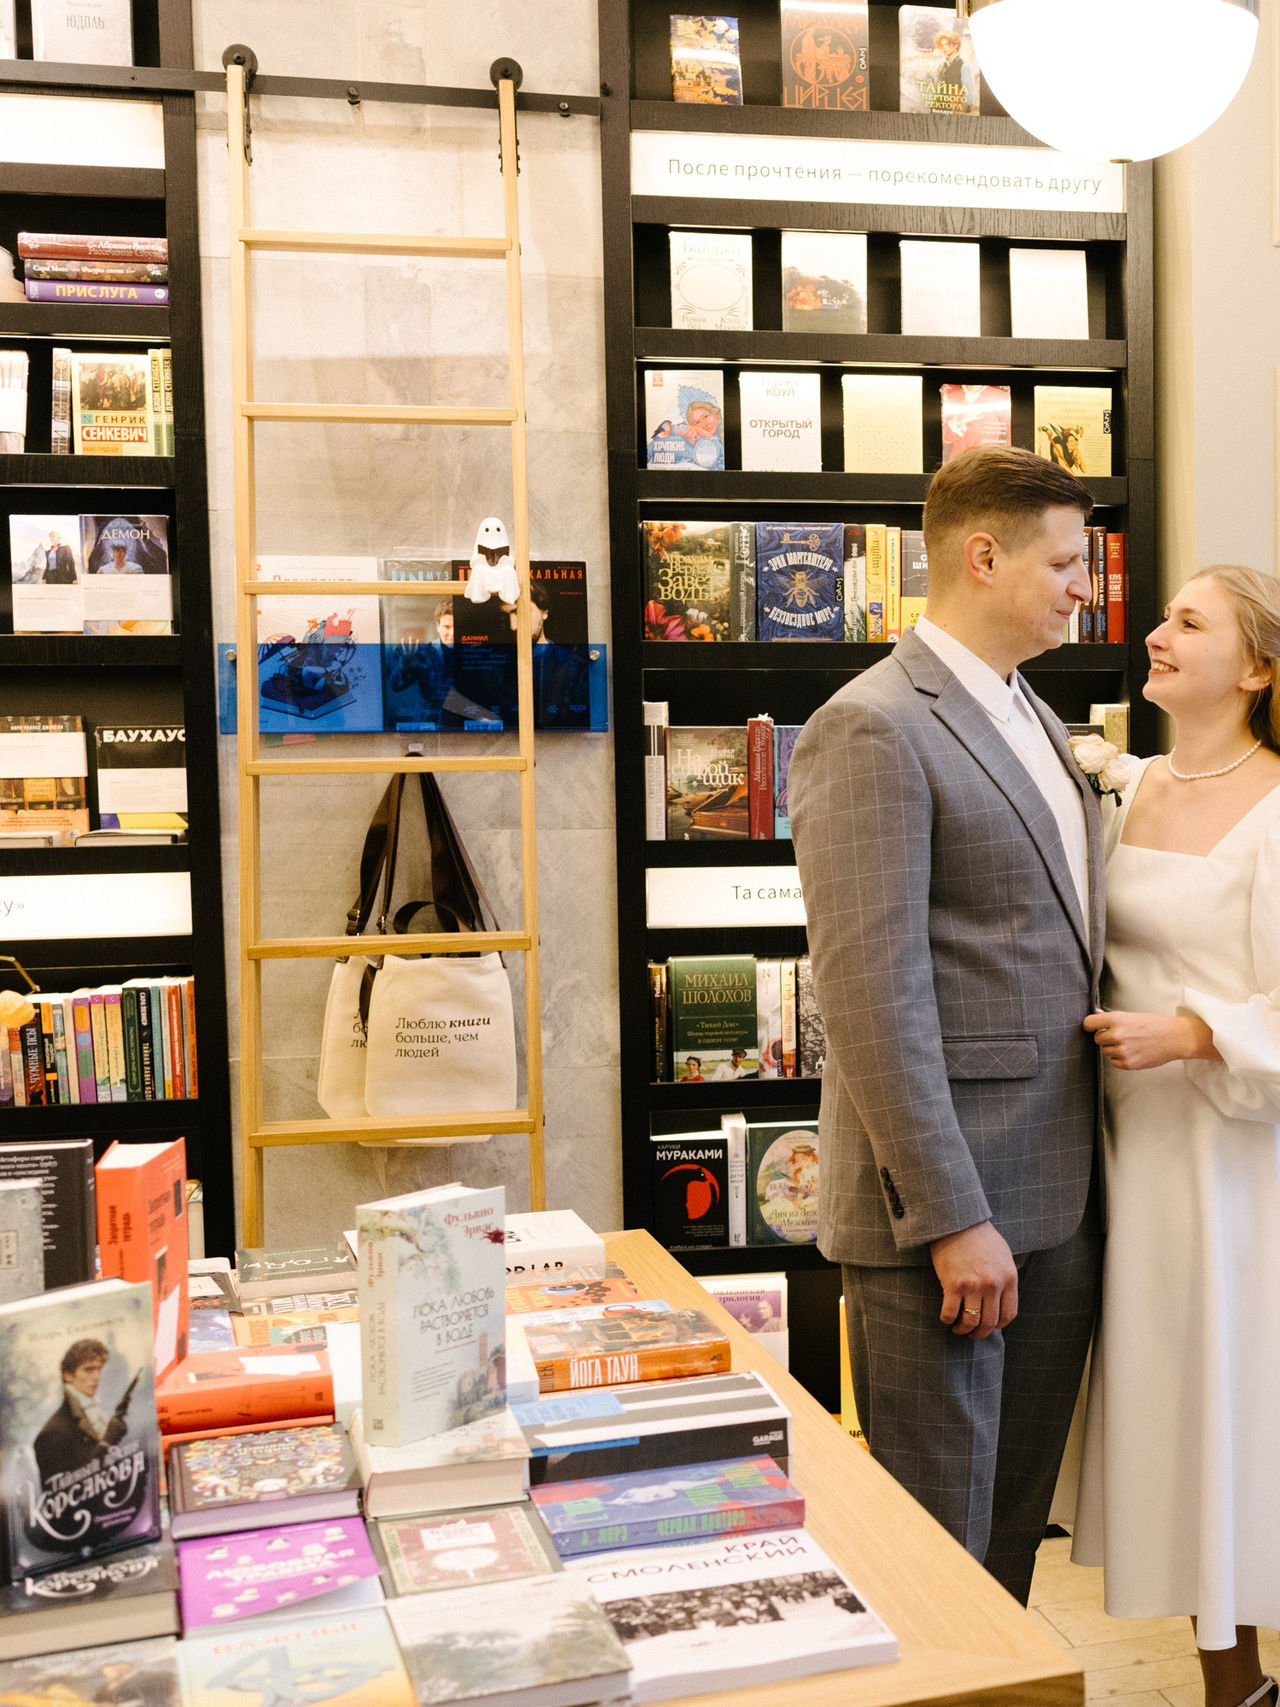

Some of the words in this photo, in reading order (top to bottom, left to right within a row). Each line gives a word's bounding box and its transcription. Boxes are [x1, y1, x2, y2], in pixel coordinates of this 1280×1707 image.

[66, 14, 105, 31] ЮДОЛЬ
[784, 14, 864, 34] МИЛЛЕР
[916, 81, 969, 96] ТАЙНА
[784, 85, 867, 110] ЦИРЦЕЯ
[922, 93, 968, 103] МЕРТВОГО
[925, 101, 963, 110] РЕКТОРА
[668, 159, 729, 177] После
[734, 163, 842, 182] прочтения
[868, 168, 1044, 190] порекомендовать
[1048, 176, 1102, 195] другу
[33, 264, 50, 273] Сара
[55, 284, 139, 299] ПРИСЛУГА
[682, 314, 707, 323] Роман
[766, 388, 795, 397] КОУЛ
[95, 416, 146, 424] ГЕНРИК
[750, 419, 813, 429] ОТКРЫТЫЙ
[82, 427, 147, 442] СЕНКЕВИЧ
[762, 429, 800, 438] ГОРОД
[653, 441, 686, 451] ХРУПКИЕ
[653, 453, 675, 464] ЛЮДИ
[101, 529, 150, 540] ДЕМОН
[660, 551, 713, 563] Абрахам
[768, 553, 787, 572] ЭРИН
[658, 569, 715, 590] Завет
[659, 587, 717, 605] воды
[815, 606, 836, 625] МОРЕ
[655, 805, 663, 830] СТРАНЕ
[731, 885, 752, 901] Та
[685, 972, 749, 988] МИХАИЛ
[139, 992, 147, 1006] САРА
[682, 989, 752, 1005] ШОЛОХОВ
[395, 1017, 446, 1030] Люблю
[449, 1017, 491, 1029] книги
[26, 1028, 37, 1045] ПСЫ
[395, 1032, 451, 1044] больше,
[454, 1033, 479, 1043] чем
[142, 1043, 150, 1065] ТАЙНАЯ
[395, 1047, 439, 1059] людей
[29, 1045, 40, 1084] ЧУМНЫЕ
[143, 1066, 151, 1085] ЛАВКА
[656, 1149, 723, 1161] МУРАКАМИ
[444, 1206, 494, 1226] Фульвио
[122, 1212, 132, 1242] тетрадь
[413, 1298, 447, 1319] ПОКА
[451, 1287, 495, 1307] ЛЮБОВЬ
[718, 1295, 761, 1304] трилогия
[420, 1303, 489, 1334] РАСТВОРЯЕТСЯ
[436, 1333, 443, 1346] В
[446, 1323, 474, 1344] ВОДЕ
[570, 1355, 603, 1388] ЙОГА
[605, 1353, 639, 1382] ТАУН
[752, 1432, 785, 1444] GARAGE
[724, 1535, 799, 1555] КРАЙ
[587, 1545, 807, 1584] СМОЛЕНСКИЙ
